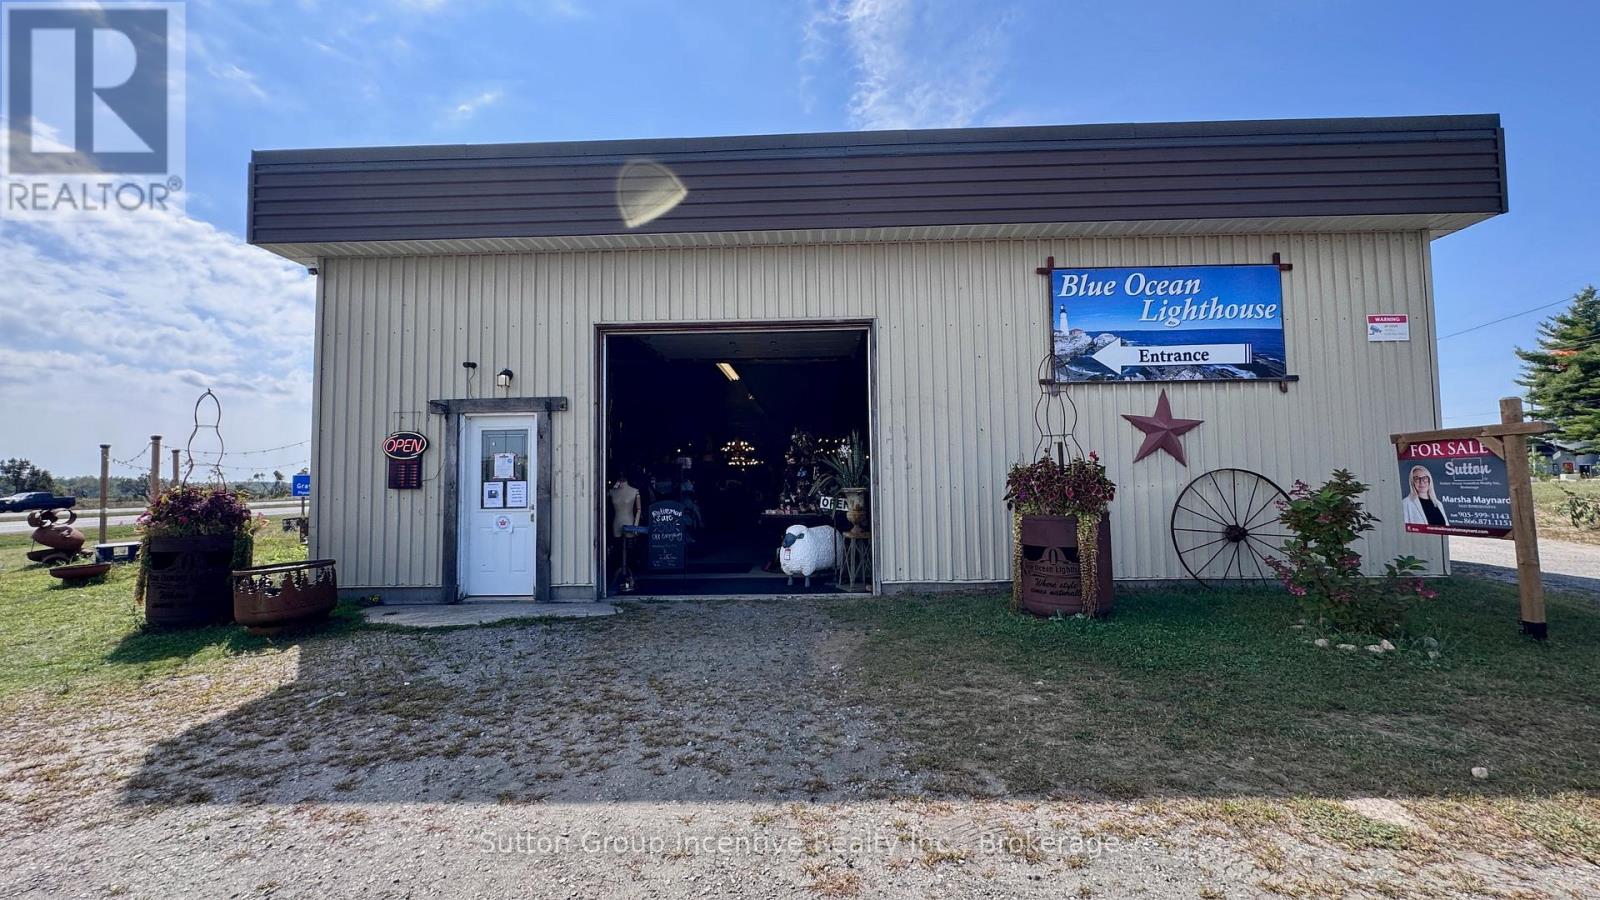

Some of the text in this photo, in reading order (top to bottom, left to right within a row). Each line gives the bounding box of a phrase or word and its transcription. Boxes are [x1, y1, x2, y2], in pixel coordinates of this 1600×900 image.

[1057, 272, 1201, 298] Blue Ocean
[1138, 297, 1277, 328] Lighthouse
[1138, 349, 1210, 363] Entrance
[385, 438, 423, 453] OPEN
[1410, 440, 1489, 458] FOR SALE
[1445, 461, 1492, 476] Sutton
[1442, 495, 1512, 505] Marsha Maynard
